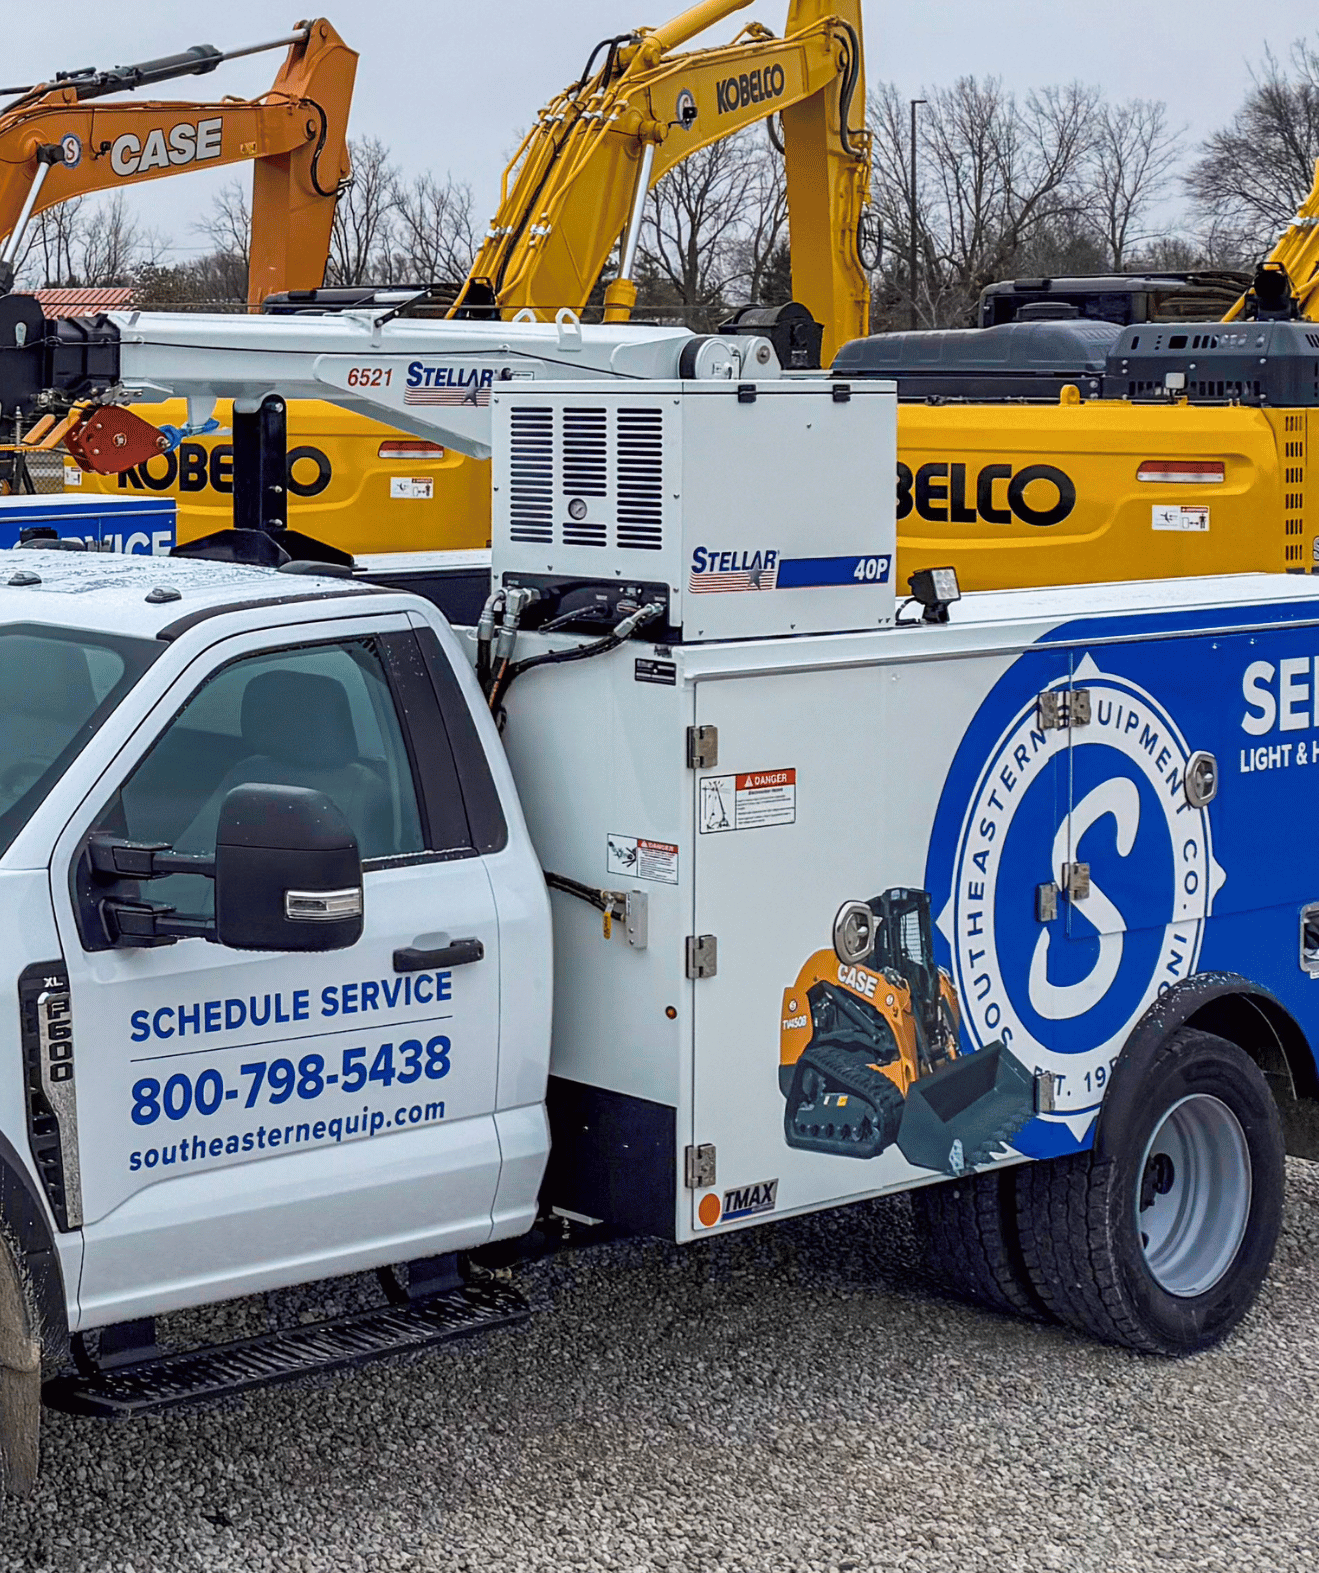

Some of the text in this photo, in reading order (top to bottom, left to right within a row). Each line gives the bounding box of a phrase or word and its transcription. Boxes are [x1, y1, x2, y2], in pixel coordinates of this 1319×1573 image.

[716, 63, 785, 115] KOBELCO
[111, 116, 223, 176] CASE
[347, 361, 494, 387] 6521 STELLAR
[118, 443, 332, 497] KOBEO
[691, 546, 888, 581] STELLAR 40P
[1241, 656, 1319, 736] SE
[754, 773, 787, 786] DANGER
[1240, 744, 1292, 773] LIGHT
[1296, 741, 1308, 765] &
[967, 728, 1047, 1046] SOUTHEASTERN
[1057, 699, 1192, 815] UIPMENT
[1182, 838, 1199, 910] CO.
[43, 976, 64, 988] XL
[130, 970, 452, 1042] SCHEDULE SERVICE
[837, 963, 878, 998] CASE
[47, 999, 73, 1083] F600
[130, 1035, 451, 1125] 800-798-5438
[129, 1101, 446, 1171] southeasternequip.com
[724, 1182, 774, 1212] TMAX
